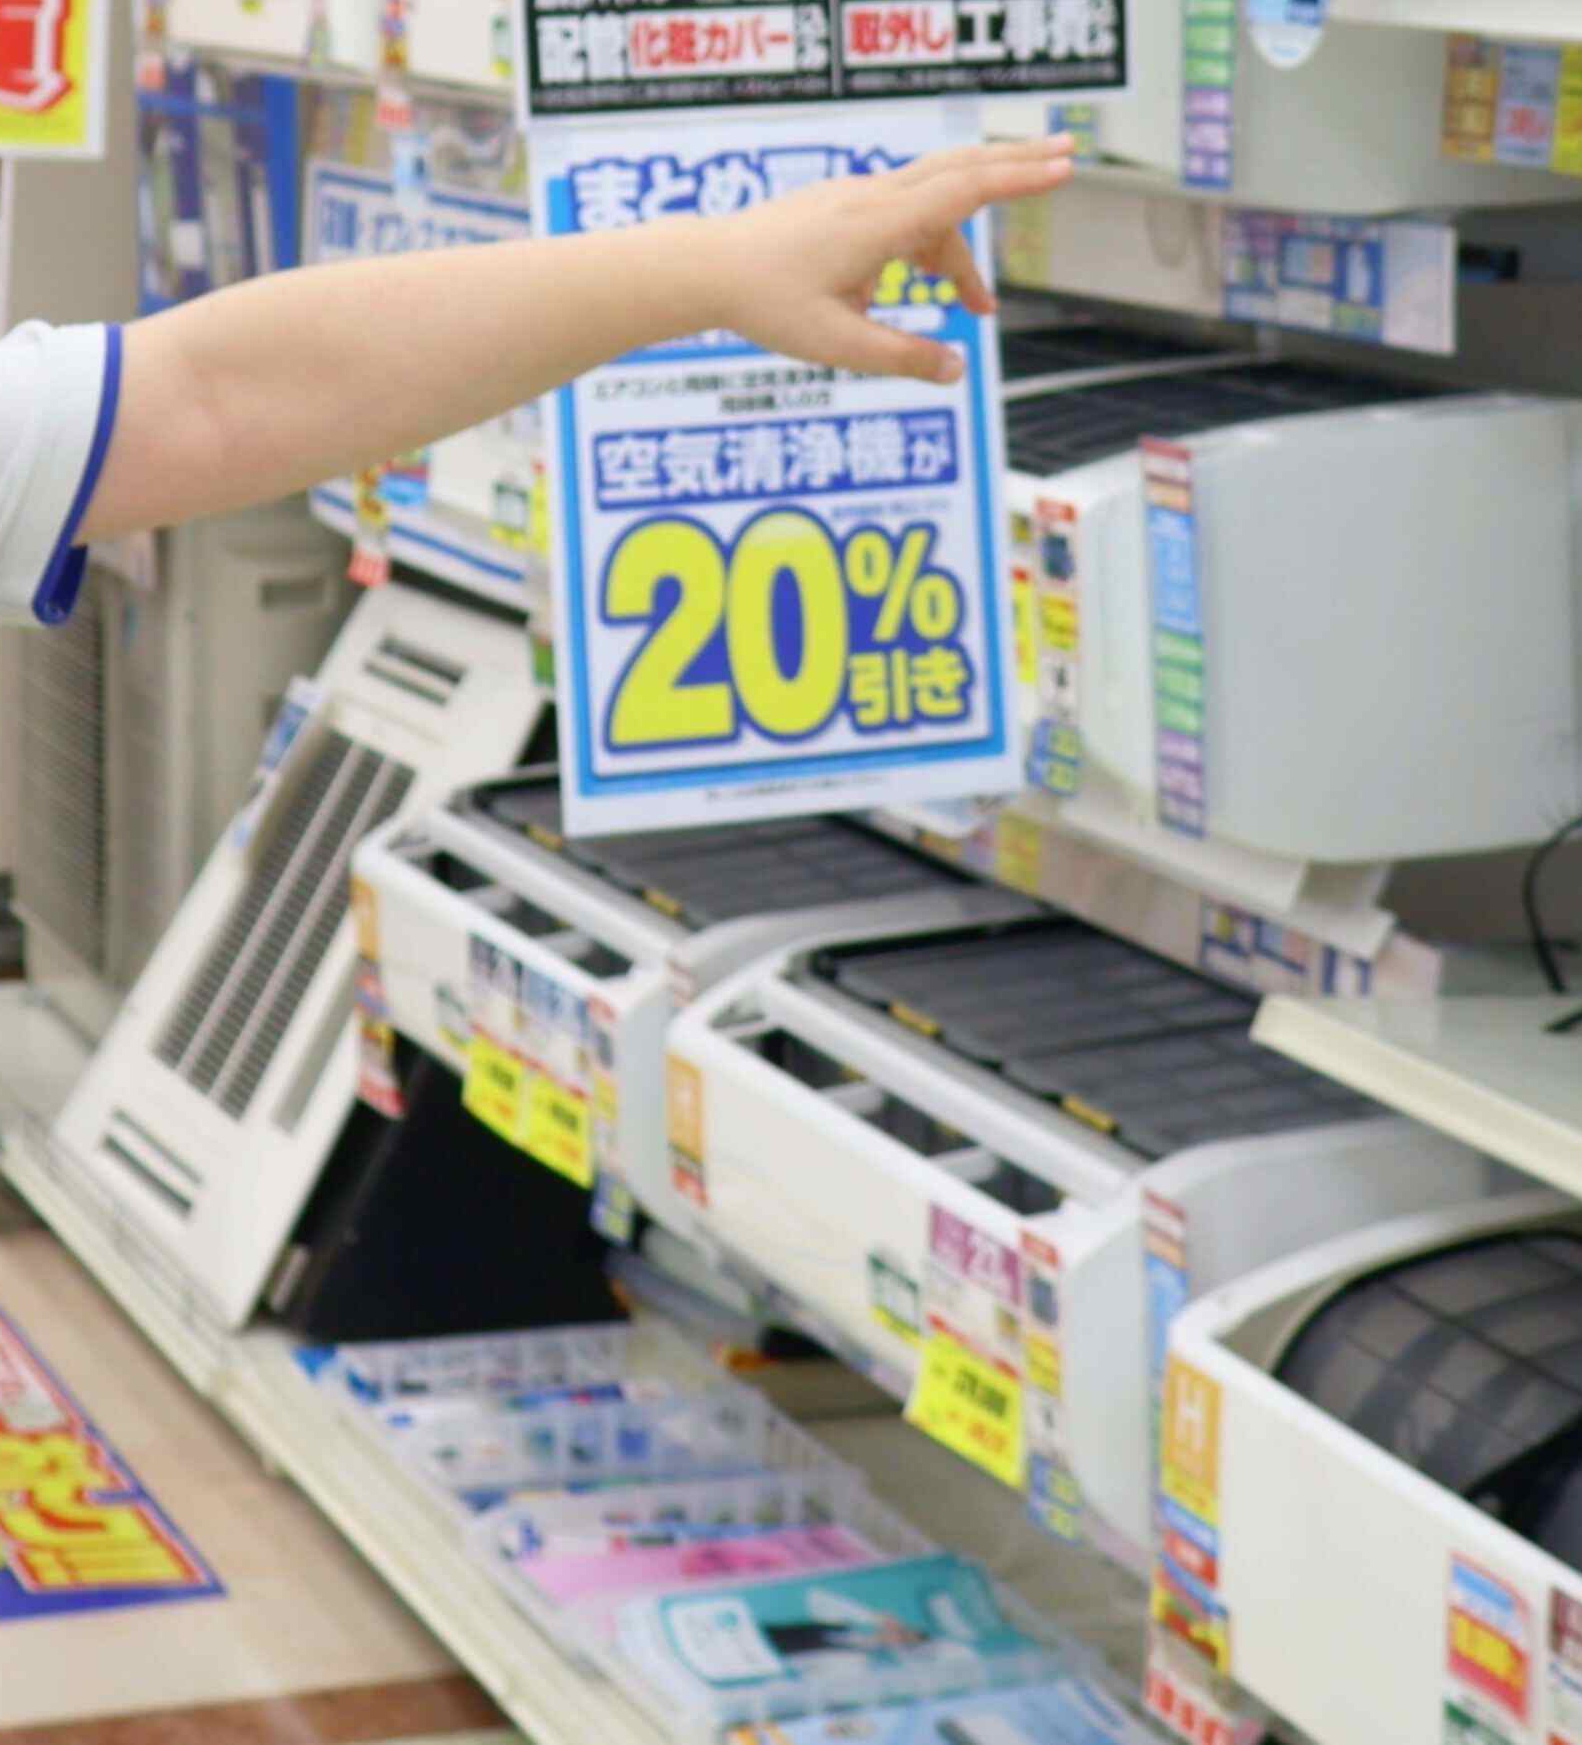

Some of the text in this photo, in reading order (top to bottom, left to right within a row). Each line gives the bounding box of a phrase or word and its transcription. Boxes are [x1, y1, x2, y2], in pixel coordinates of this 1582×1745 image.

[598, 415, 953, 505] 空気清浄機が
[848, 648, 970, 727] 引き
